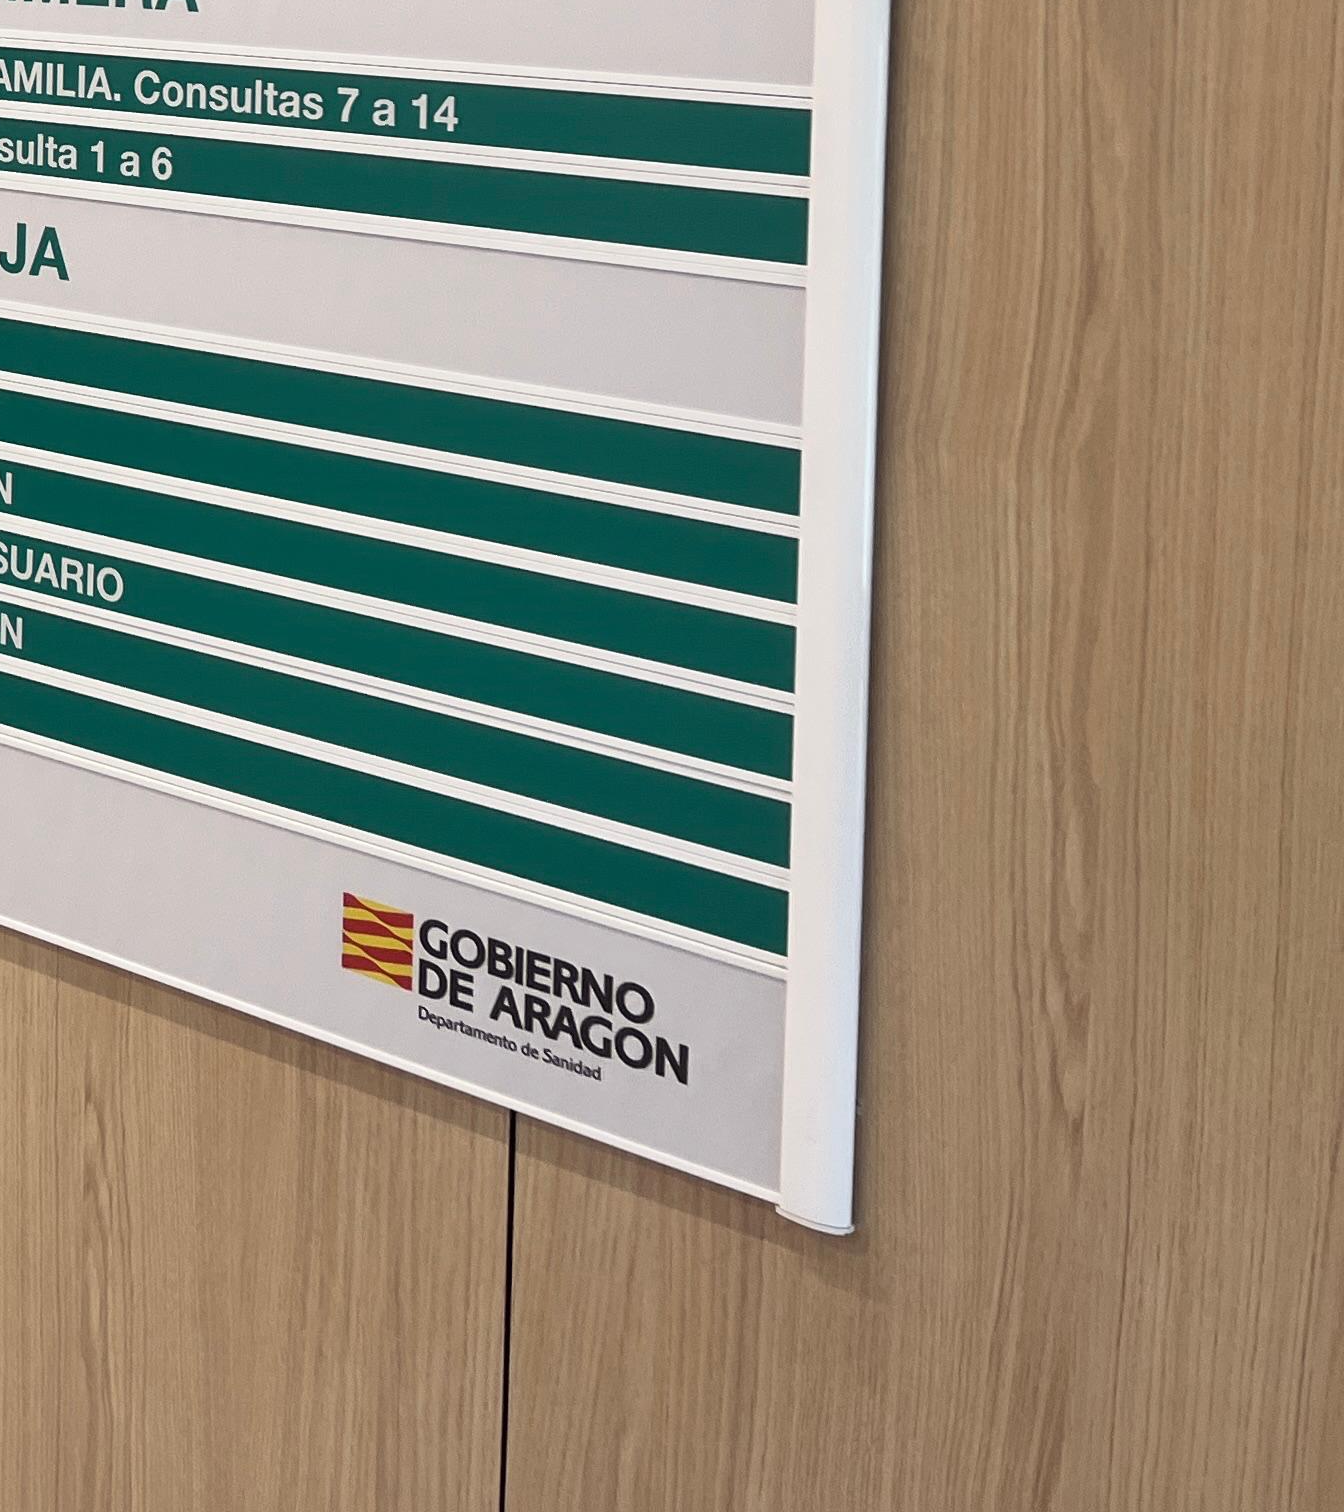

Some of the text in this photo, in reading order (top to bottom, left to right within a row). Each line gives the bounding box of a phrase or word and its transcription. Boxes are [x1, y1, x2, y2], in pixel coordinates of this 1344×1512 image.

[135, 70, 323, 119] Consultas
[338, 87, 359, 122] 7
[373, 99, 395, 126] a
[412, 94, 458, 131] 14
[91, 141, 103, 173] 1
[120, 152, 139, 177] a
[152, 147, 172, 180] 6
[419, 920, 655, 1024] GOBIERNO
[419, 959, 690, 1086] DE ARAGON
[419, 1006, 601, 1081] Departamento de Sanidad
